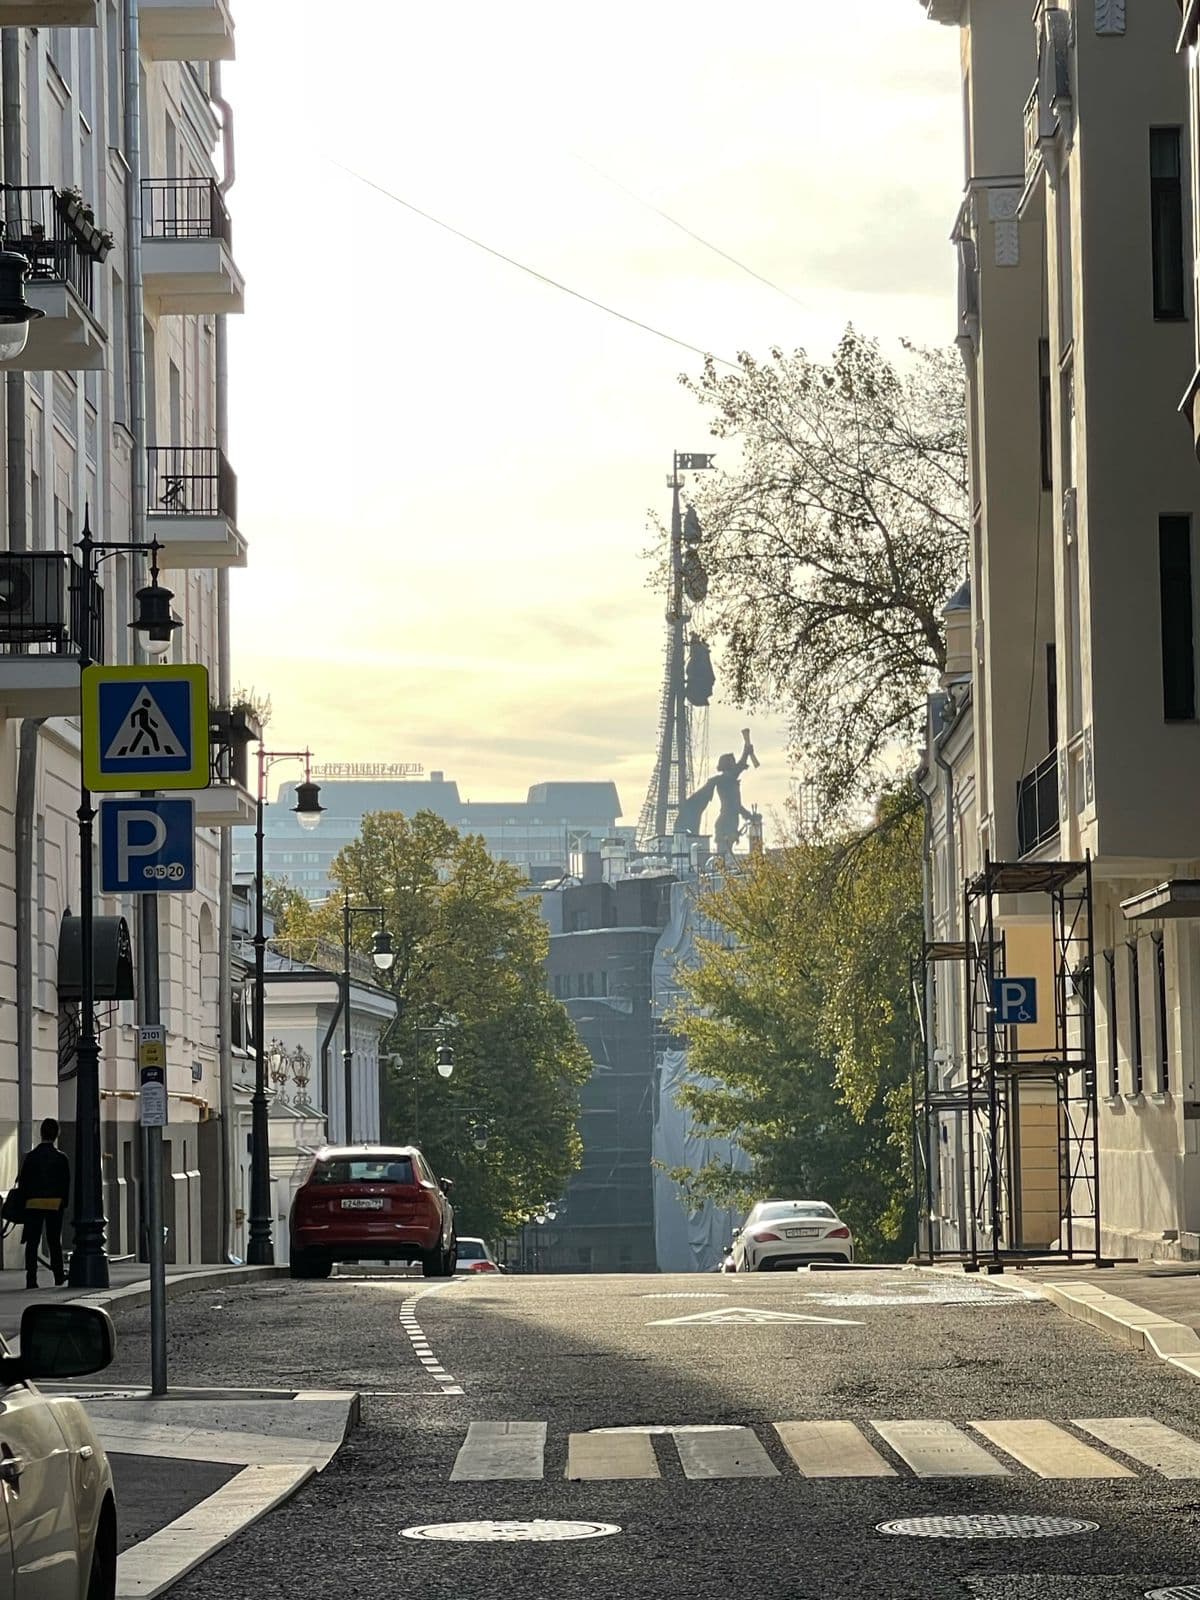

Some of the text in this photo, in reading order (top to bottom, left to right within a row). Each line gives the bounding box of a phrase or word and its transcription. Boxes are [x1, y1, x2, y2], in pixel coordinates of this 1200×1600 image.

[117, 810, 167, 882] P
[145, 866, 184, 877] 10 15 20
[1002, 983, 1027, 1019] P
[142, 1031, 160, 1040] 2101
